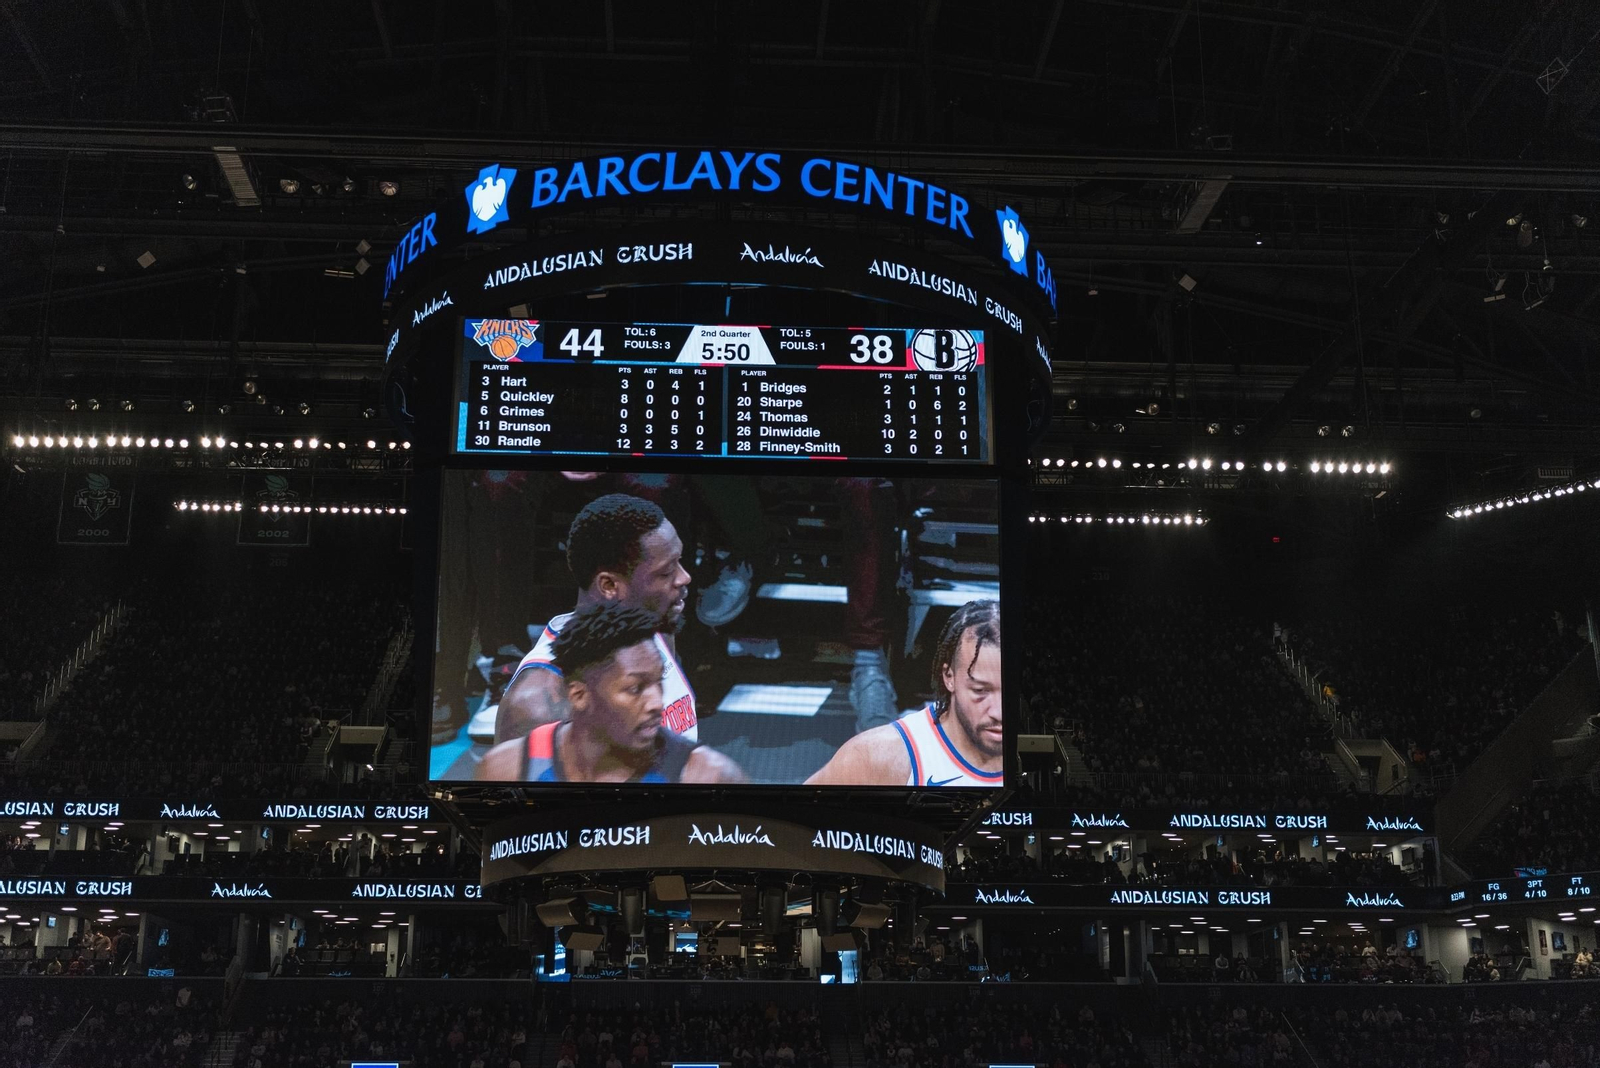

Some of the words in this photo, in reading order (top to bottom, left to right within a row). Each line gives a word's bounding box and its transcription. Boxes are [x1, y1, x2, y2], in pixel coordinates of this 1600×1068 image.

[531, 150, 781, 209] BARCLAYS
[800, 158, 974, 239] CENTER
[739, 242, 825, 268] Andalucía
[483, 248, 603, 290] ANDALUSIAN
[616, 242, 693, 264] CRUSH
[868, 259, 978, 306] ANDALUSIAN
[985, 297, 1023, 334] CRUSH
[477, 319, 533, 340] KNICKS
[624, 327, 649, 337] TOL:
[649, 327, 657, 337] 6
[700, 329, 717, 338] 2nd
[719, 330, 751, 338] Quarter
[779, 328, 804, 338] TOL:
[805, 329, 812, 338] 5
[559, 328, 605, 357] 44
[624, 339, 663, 350] FOULS:
[664, 341, 671, 350] 3
[780, 341, 818, 351] FOULS:
[820, 342, 825, 351] 1
[849, 334, 894, 364] 38
[702, 343, 750, 361] 5:50
[643, 367, 658, 375] AST
[694, 368, 707, 376] FLS
[740, 369, 767, 377] PLAYER
[481, 375, 490, 386] 3
[500, 376, 527, 387] Hart
[621, 378, 629, 390] 3
[646, 379, 655, 390] 0
[671, 380, 680, 391] 4
[698, 380, 705, 391] 1
[741, 381, 748, 392] 1
[760, 381, 807, 395] Bridges
[883, 384, 891, 395] 2
[909, 385, 916, 395] 1
[934, 385, 941, 396] 1
[958, 386, 966, 396] 0
[481, 390, 489, 401] 5
[500, 390, 555, 405] Quickley
[620, 393, 629, 404] 8
[646, 394, 654, 405] 0
[671, 394, 680, 405] 0
[696, 395, 705, 406] 0
[736, 396, 752, 407] 20
[759, 396, 803, 410] Sharpe
[885, 399, 891, 410] 1
[908, 399, 917, 410] 0
[933, 400, 942, 411] 6
[958, 400, 967, 411] 2
[480, 405, 489, 416] 6
[499, 405, 545, 417] Grimes
[620, 408, 628, 419] 0
[645, 409, 654, 420] 0
[670, 409, 679, 420] 0
[698, 410, 704, 421] 1
[736, 411, 752, 422] 24
[759, 411, 809, 423] Thomas
[883, 413, 892, 424] 3
[910, 414, 916, 425] 1
[935, 414, 941, 425] 1
[960, 415, 967, 426] 1
[477, 420, 490, 431] 11
[498, 420, 551, 432] Brunson
[619, 423, 628, 434] 3
[645, 423, 653, 435] 3
[670, 424, 679, 435] 5
[696, 425, 705, 436] 0
[736, 425, 752, 437] 26
[759, 426, 821, 438] Dinwiddie
[881, 428, 896, 439] 10
[909, 429, 917, 440] 2
[934, 429, 943, 440] 0
[959, 430, 968, 440] 0
[474, 435, 490, 446] 30
[497, 435, 542, 447] Randle
[616, 438, 631, 449] 12
[644, 438, 653, 449] 2
[670, 439, 679, 450] 3
[695, 440, 704, 451] 2
[736, 440, 751, 452] 28
[759, 441, 841, 455] Finney-Smith
[884, 443, 893, 454] 3
[909, 443, 918, 455] 0
[935, 444, 943, 455] 2
[961, 444, 967, 455] 1
[77, 528, 109, 538] 2000
[258, 529, 290, 538] 2002
[63, 802, 120, 816] CRUSH
[263, 804, 365, 819] ANDALUSIAN
[374, 805, 429, 820] CRUSH
[1169, 814, 1267, 828] ANDALUSIAN
[1275, 815, 1327, 829] CRUSH
[688, 823, 775, 847] Andalucía
[489, 830, 568, 861] ANDALUSIAN
[579, 825, 650, 848] CRUSH
[811, 829, 915, 860] ANDALUSIAN
[1487, 883, 1501, 891] FG
[1527, 879, 1543, 888] 3PT
[1571, 876, 1583, 885] FT
[75, 881, 133, 896] CRUSH
[352, 883, 455, 899] ANDALUSIAN
[1524, 891, 1531, 899] 4
[1536, 889, 1547, 898] 10
[1567, 887, 1574, 896] 8
[1579, 886, 1591, 895] 10
[1110, 890, 1209, 905] ANDALUSIAN
[1217, 891, 1271, 905] CRUSH
[1481, 893, 1492, 902] 16
